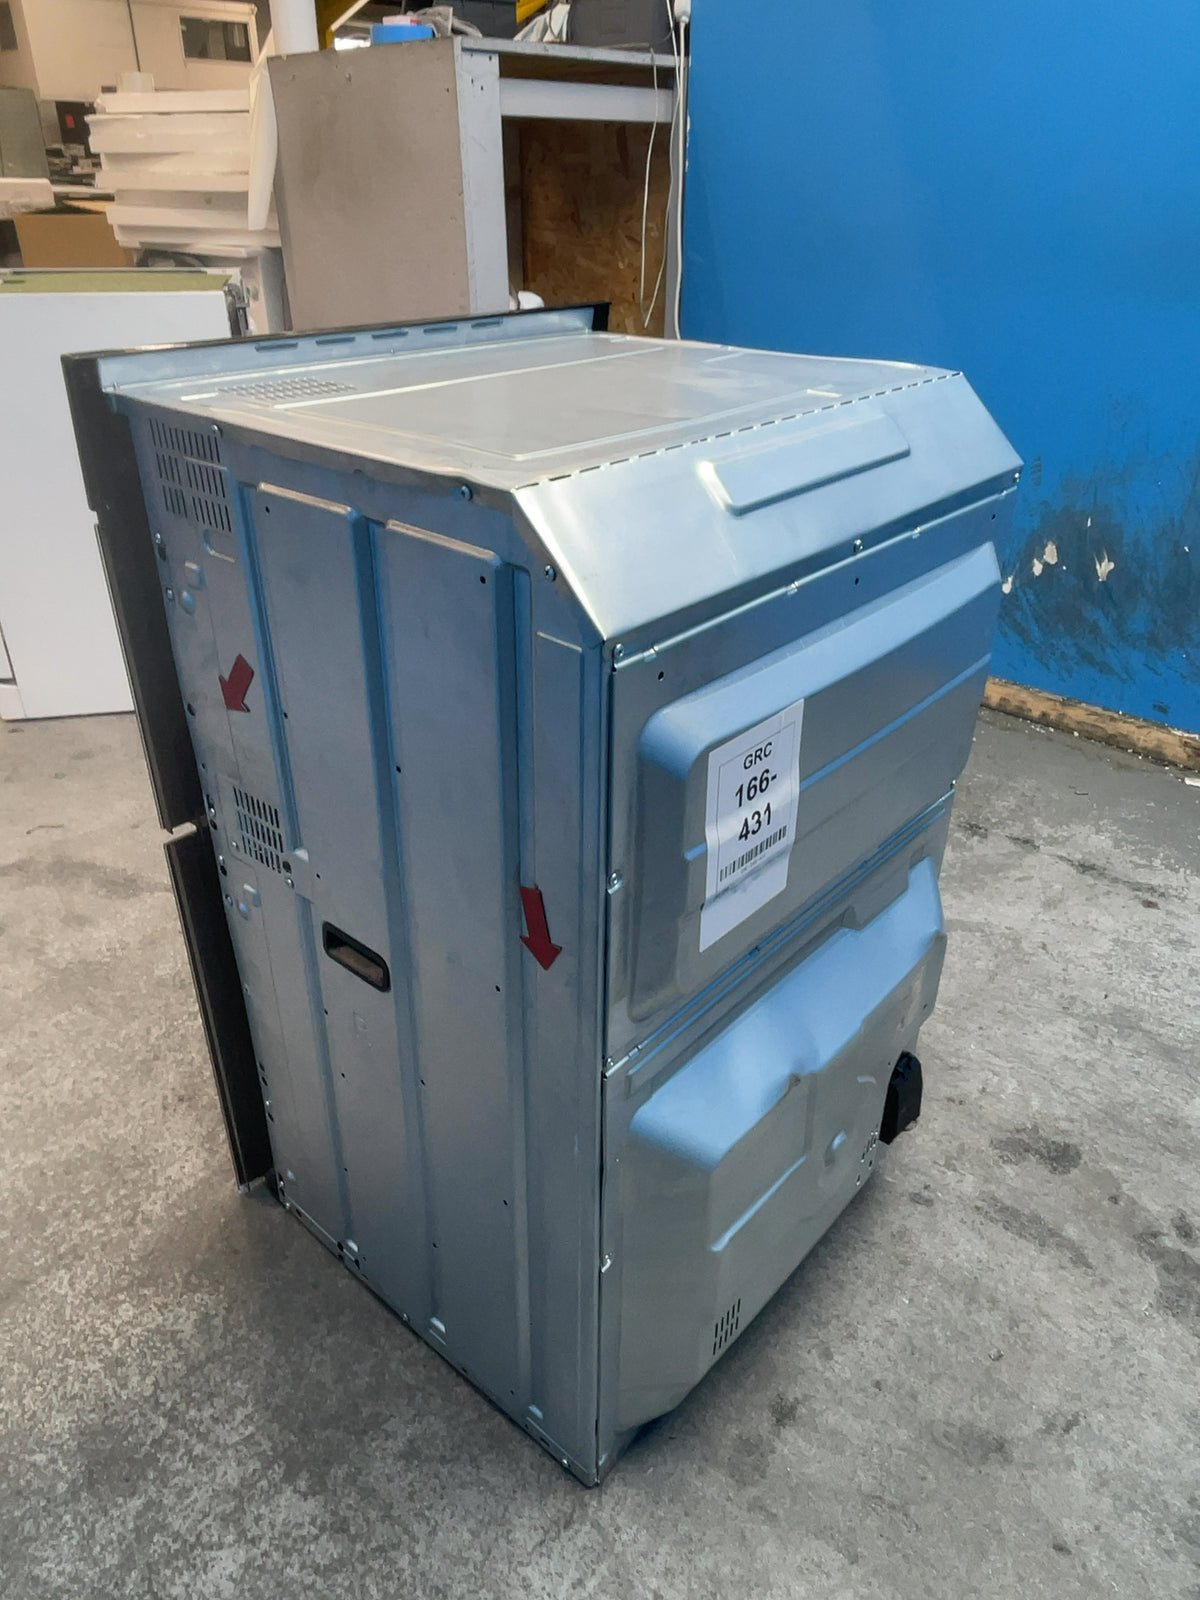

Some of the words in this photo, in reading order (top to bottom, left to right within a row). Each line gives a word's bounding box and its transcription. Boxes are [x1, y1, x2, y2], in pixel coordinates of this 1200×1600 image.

[743, 741, 773, 770] GRC
[735, 768, 777, 808] 166-
[738, 802, 771, 841] 431
